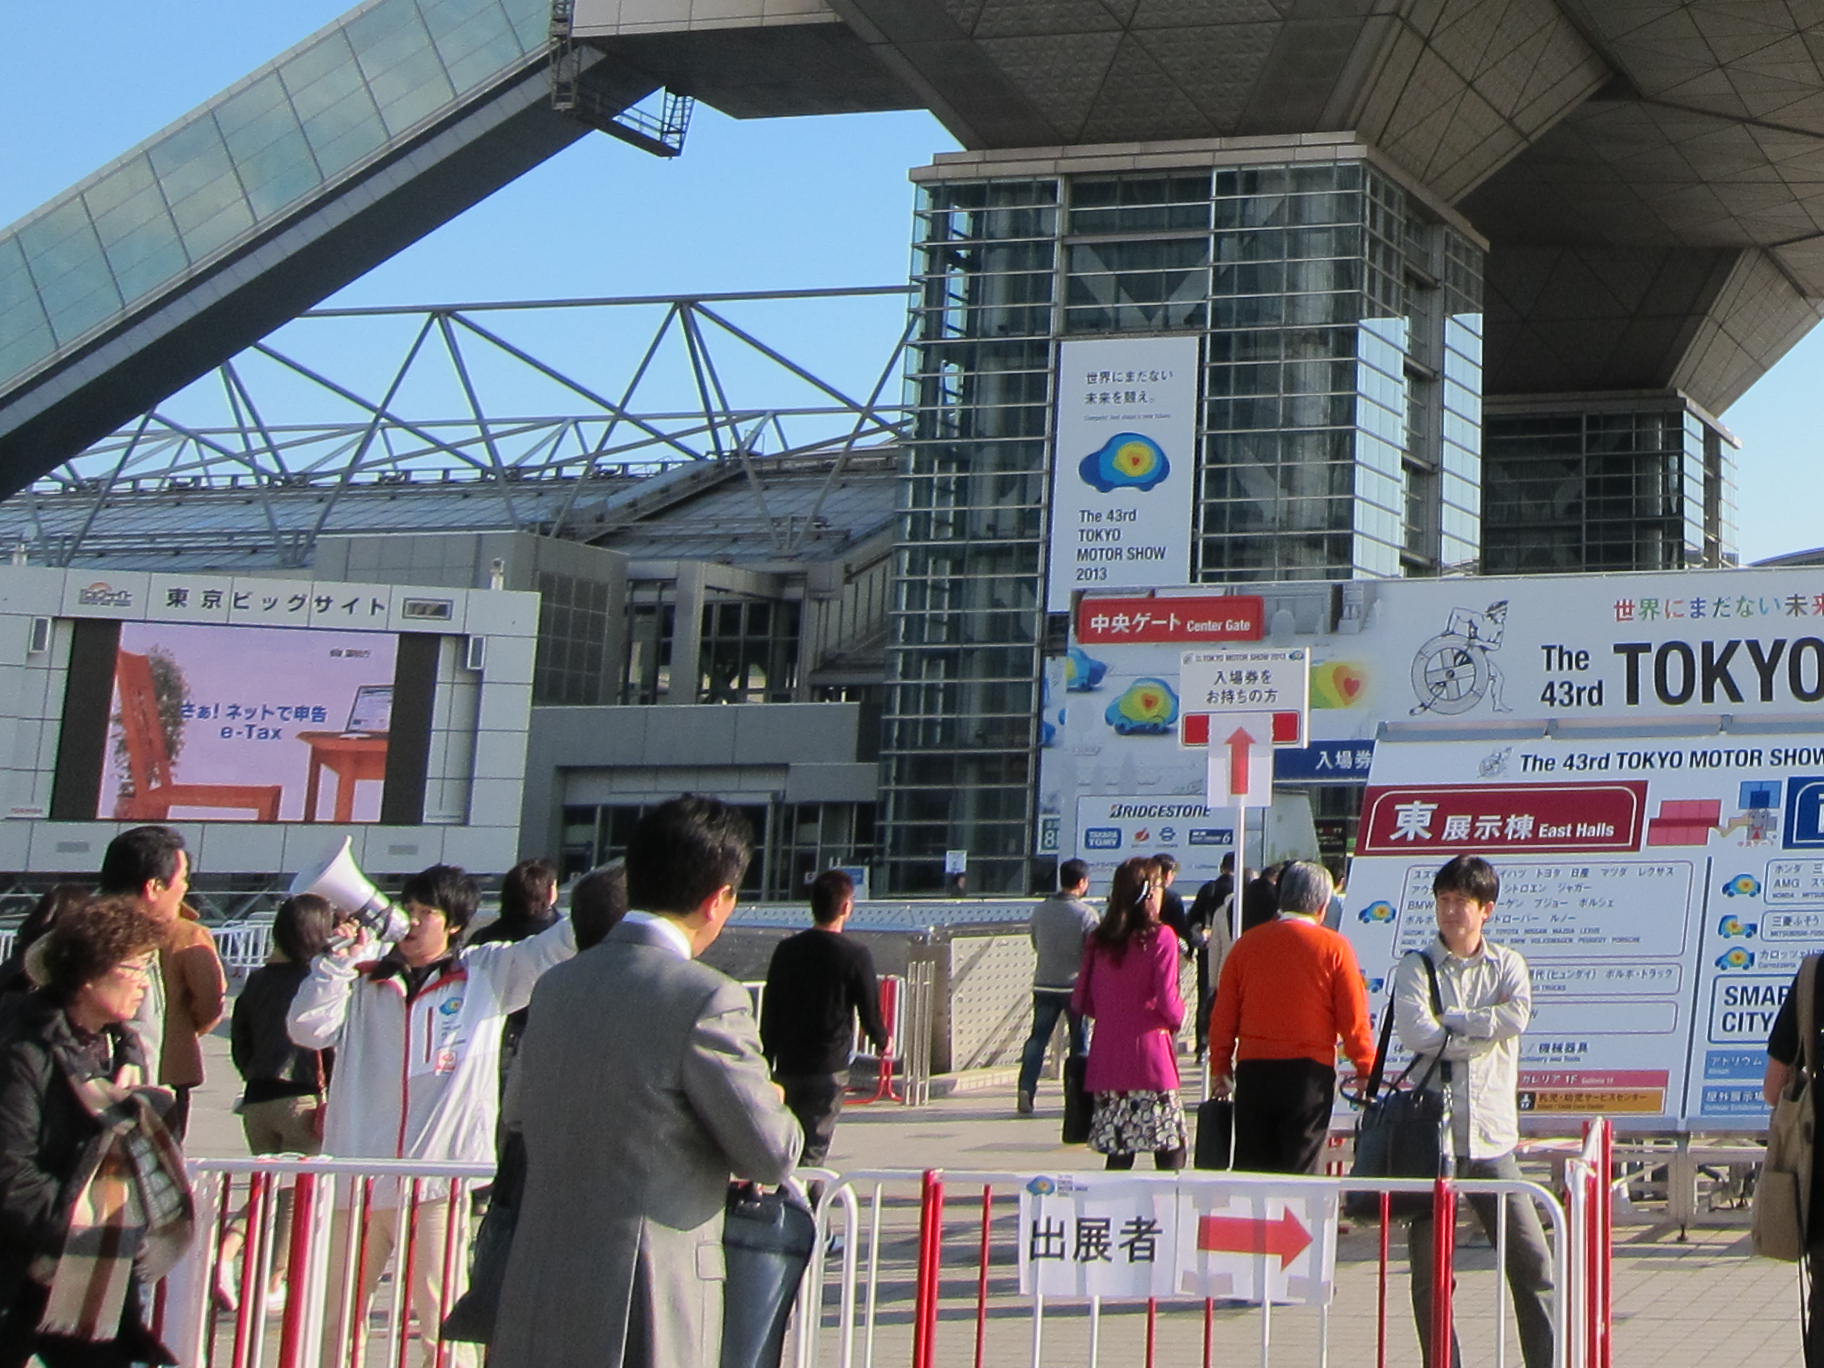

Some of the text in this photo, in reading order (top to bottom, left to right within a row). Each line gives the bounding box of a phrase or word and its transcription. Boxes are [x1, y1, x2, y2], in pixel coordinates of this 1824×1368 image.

[1079, 509, 1137, 523] The 43rd
[1078, 529, 1121, 542] TOKYO
[1077, 546, 1167, 562] MOTOR SHOW
[1076, 567, 1107, 581] 2013
[166, 587, 386, 617] 東京ビッグサイト
[1091, 612, 1251, 634] 中央ゲート Center Gate
[1540, 644, 1590, 672] The
[1214, 669, 1272, 685] 入場券を
[1206, 688, 1279, 705] お持ちの方
[1540, 679, 1603, 708] 43rd
[221, 724, 283, 740] e-Tax
[1315, 749, 1372, 770] 入場券
[1520, 754, 1556, 773] The
[1563, 752, 1611, 772] 43rd
[1616, 750, 1684, 770] TOKYO
[1688, 749, 1763, 769] MOTOR
[1109, 803, 1211, 819] BRIDGESTONE
[1539, 823, 1572, 838] East
[1576, 822, 1615, 838] Halls
[1088, 837, 1118, 847] TOMY
[1222, 834, 1230, 844] 6
[1499, 868, 1526, 879] イハツ
[1536, 868, 1561, 878] トヨタ
[1571, 867, 1590, 879] 日産
[1601, 867, 1627, 878] マツダ
[1638, 866, 1674, 877] レクサス
[1774, 863, 1803, 874] ホンダ
[1504, 883, 1547, 894] シトロエン
[1558, 882, 1593, 893] ジャガー
[1773, 879, 1800, 889] AMG
[1407, 900, 1433, 910] BMW
[1534, 898, 1569, 909] プジョー
[1550, 914, 1576, 924] ルノー
[1771, 915, 1820, 927] 三菱ふそう
[1721, 1011, 1775, 1033] CITY
[1710, 1056, 1763, 1066] アトリウム
[1522, 1074, 1561, 1084] ガレリア
[1565, 1074, 1578, 1084] 1F
[1030, 1215, 1163, 1264] 出展者
